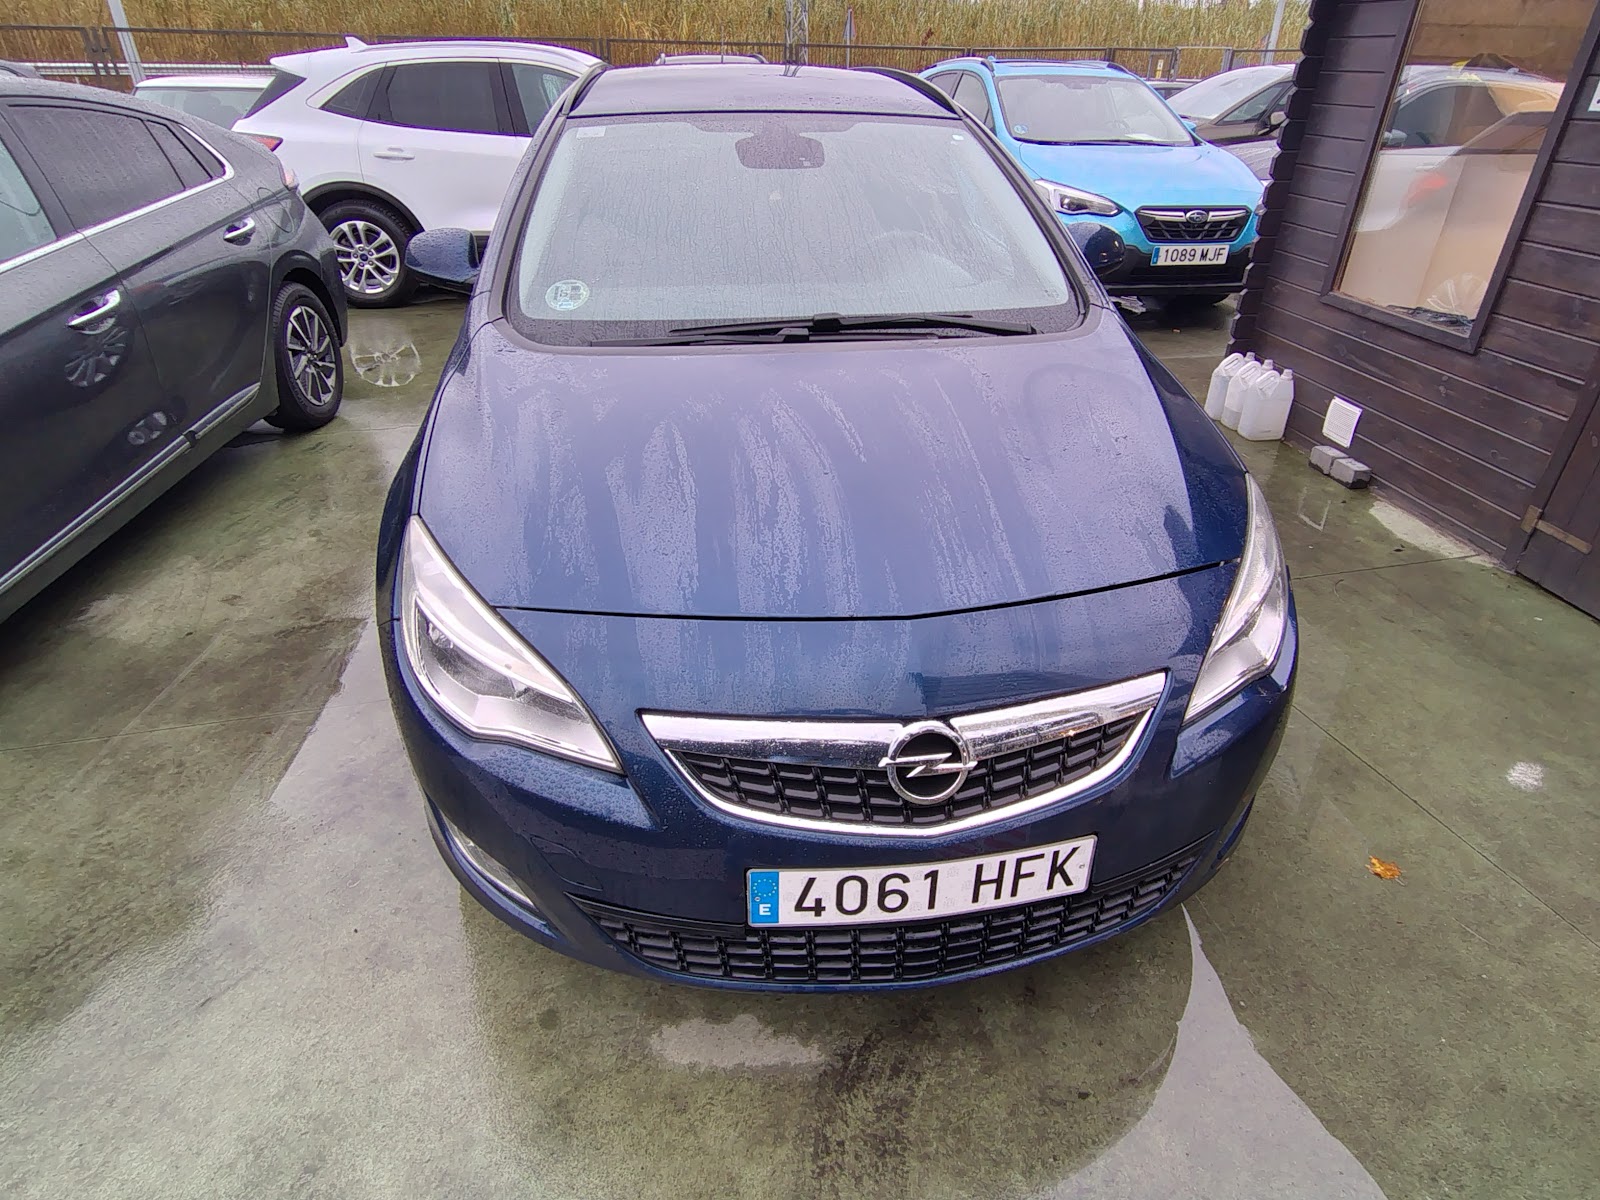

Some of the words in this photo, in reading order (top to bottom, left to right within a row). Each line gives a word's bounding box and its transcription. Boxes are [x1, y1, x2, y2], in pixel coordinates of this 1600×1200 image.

[1164, 248, 1197, 262] 1089
[1199, 247, 1226, 262] MJF
[794, 869, 940, 917] 4061
[972, 846, 1081, 904] HFK
[759, 903, 771, 916] E
